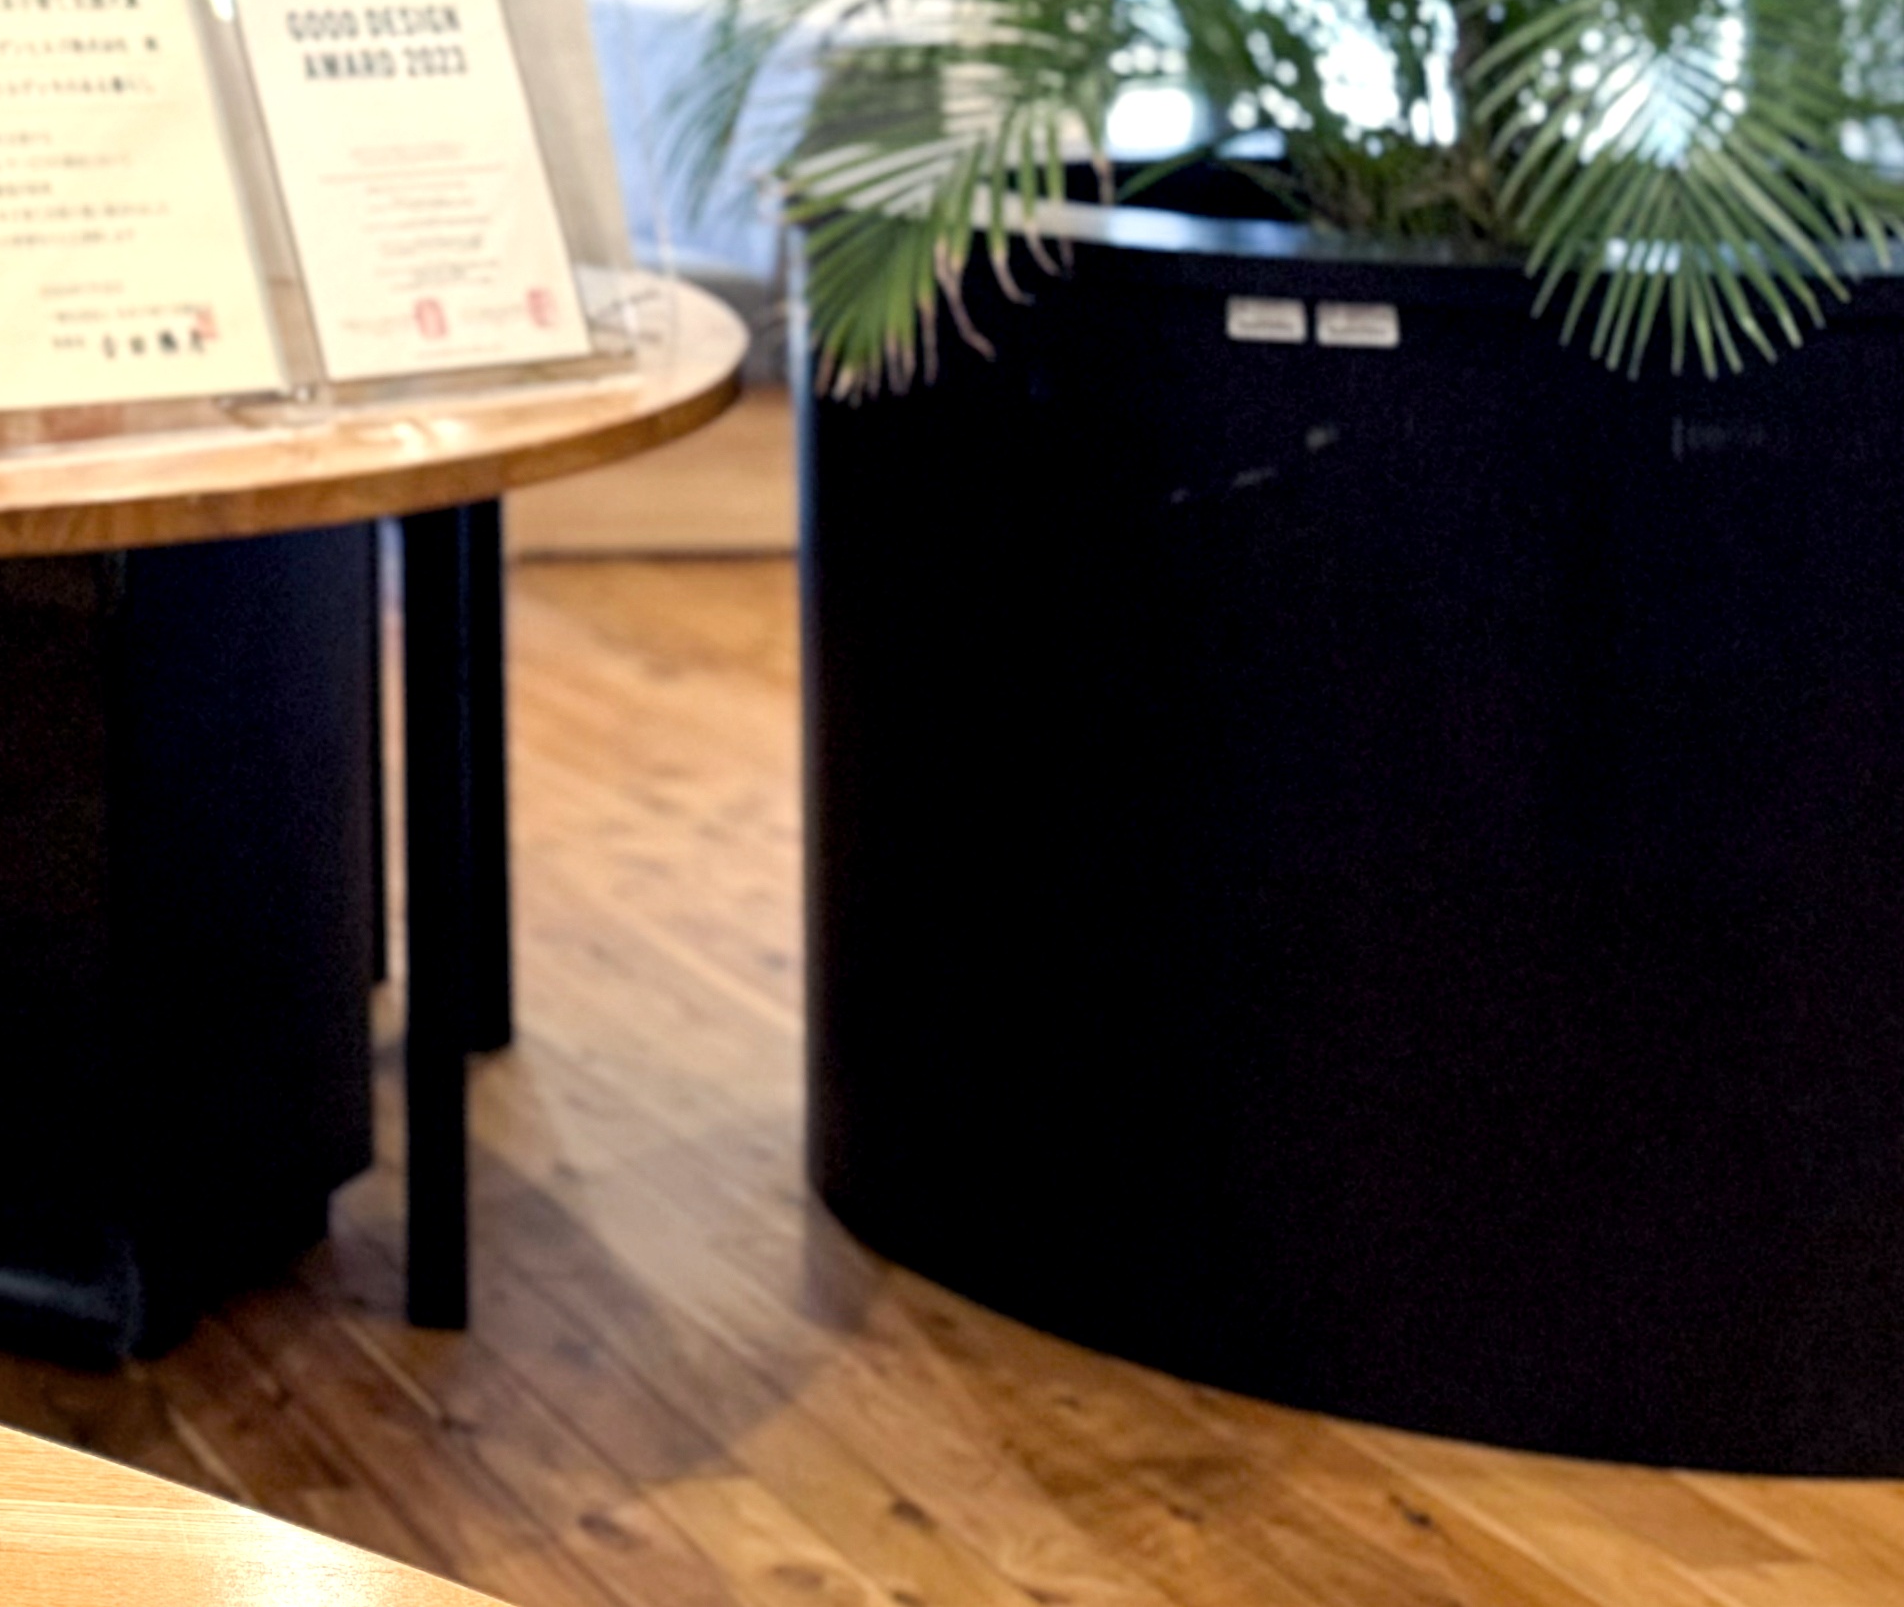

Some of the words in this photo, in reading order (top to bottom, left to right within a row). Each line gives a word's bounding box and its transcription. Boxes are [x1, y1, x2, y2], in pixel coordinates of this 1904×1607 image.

[286, 7, 360, 42] GOOD
[364, 4, 462, 38] DESIGN
[303, 48, 396, 83] AWARD
